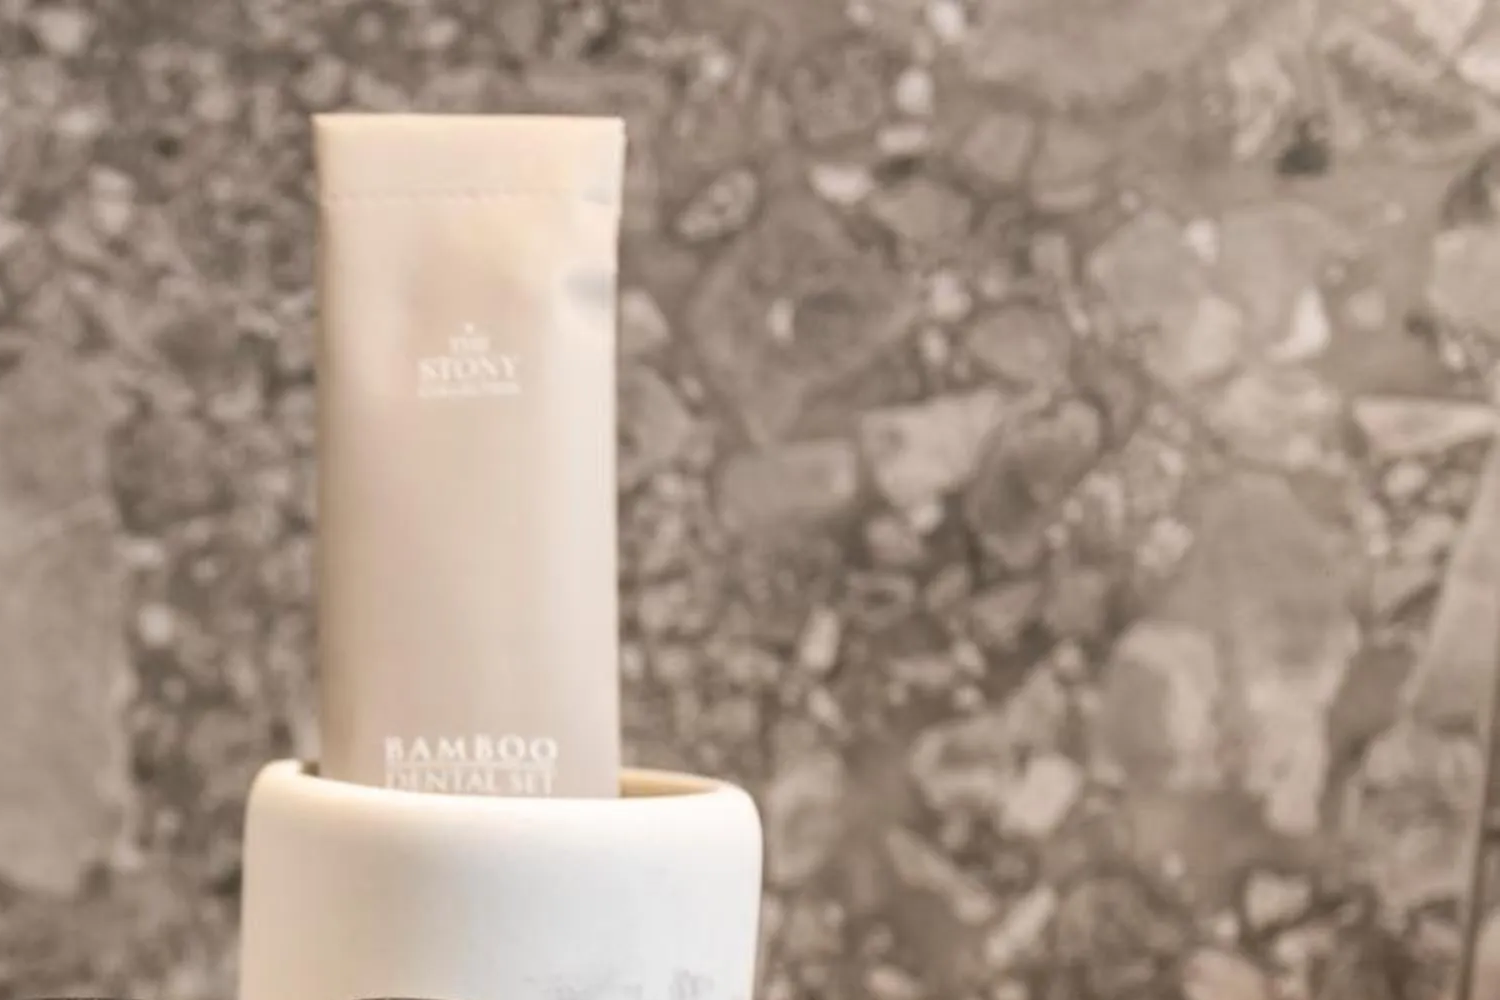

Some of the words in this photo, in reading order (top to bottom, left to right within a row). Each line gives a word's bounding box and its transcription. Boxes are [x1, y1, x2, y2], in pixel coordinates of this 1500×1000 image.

[417, 353, 521, 381] STONY
[384, 733, 559, 761] BAMBOO
[385, 766, 498, 793] DENTAL
[511, 766, 554, 794] SET
